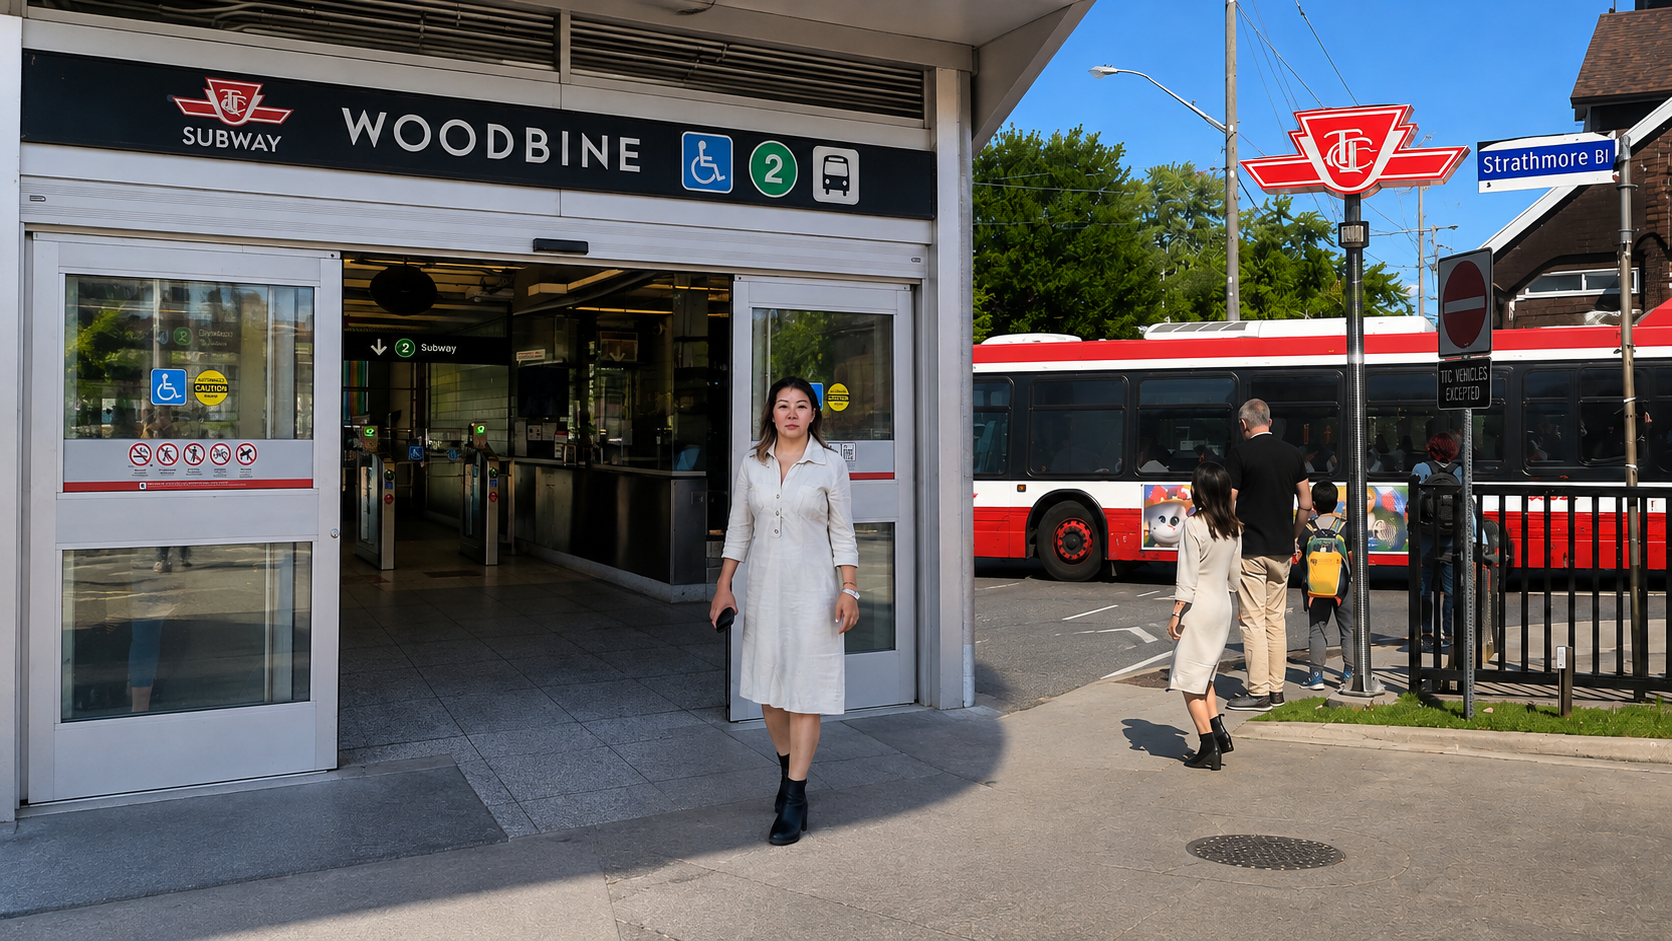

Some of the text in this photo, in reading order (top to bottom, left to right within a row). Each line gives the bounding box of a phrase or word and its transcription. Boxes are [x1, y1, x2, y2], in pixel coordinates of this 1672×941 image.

[182, 126, 282, 153] SUBWAY
[341, 107, 641, 173] WOODBINE
[764, 153, 784, 184] 2
[1483, 151, 1589, 174] Strathmore
[402, 342, 457, 355] 2 Subway
[1440, 366, 1487, 383] TTC VEHICLES
[1446, 386, 1479, 401] EXCEPTED
